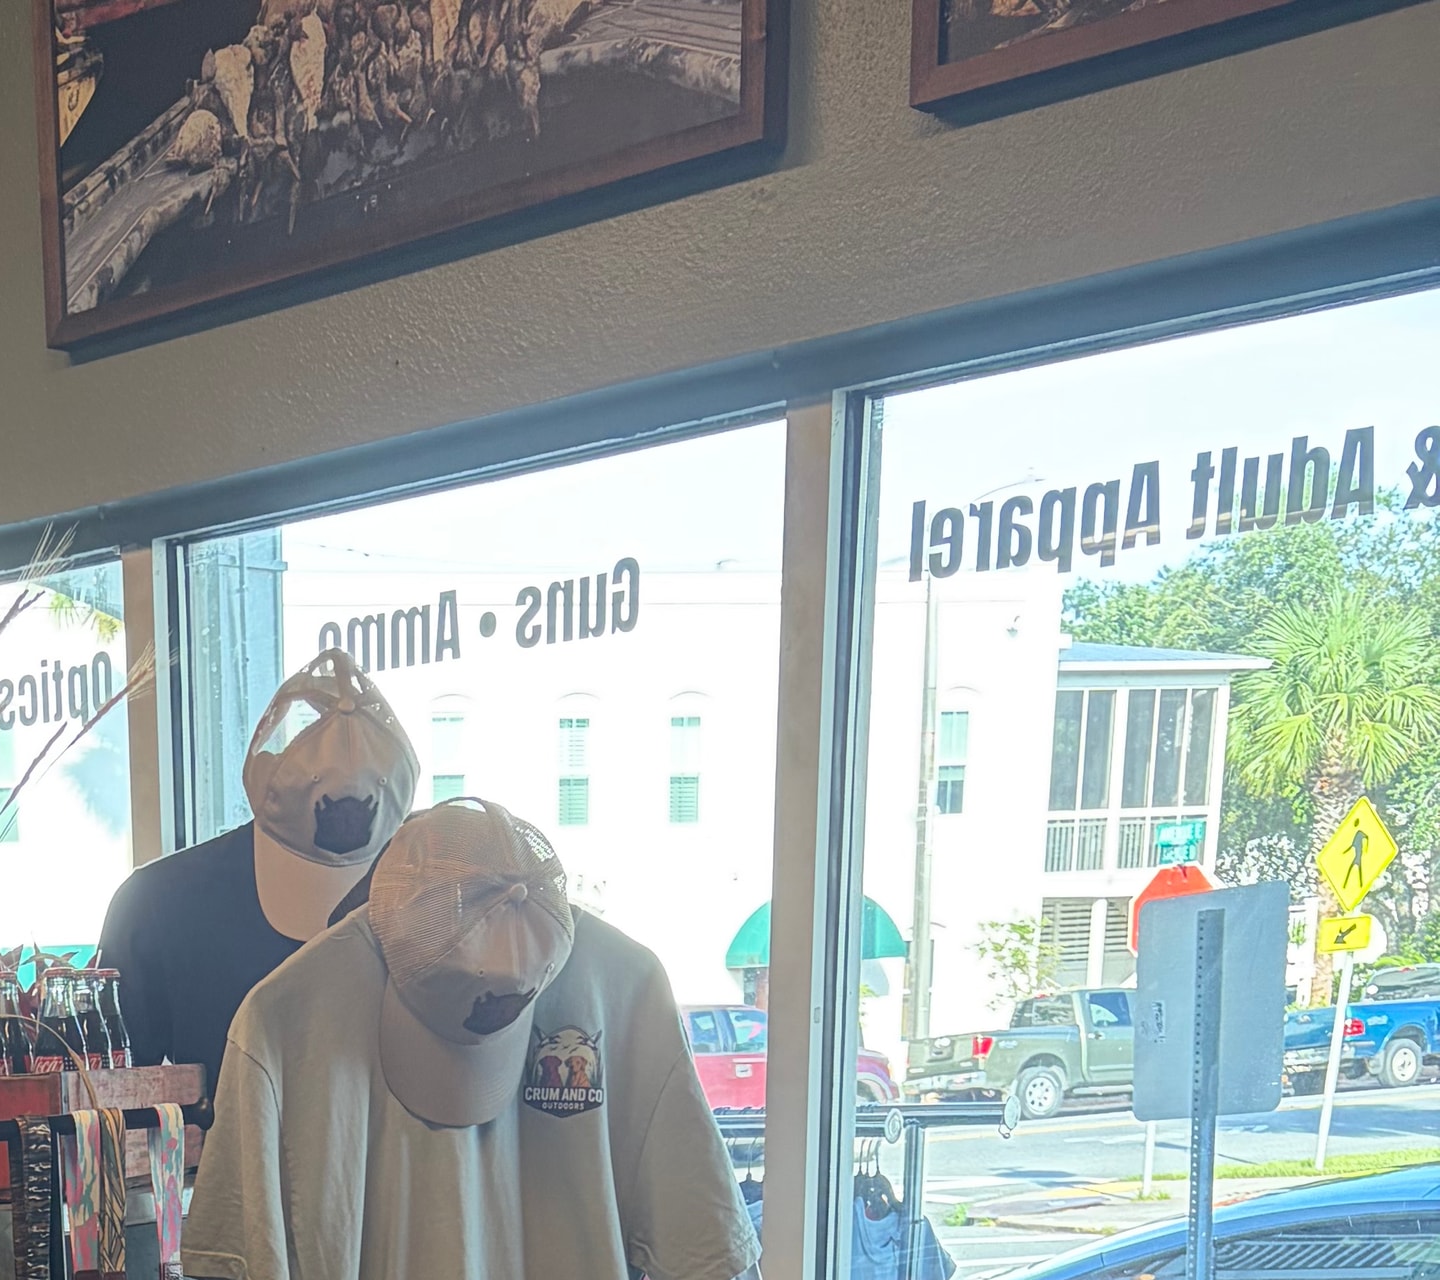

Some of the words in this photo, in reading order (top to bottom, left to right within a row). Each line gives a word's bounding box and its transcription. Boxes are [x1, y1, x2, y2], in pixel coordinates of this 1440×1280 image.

[524, 1087, 560, 1101] CRUM
[561, 1088, 586, 1102] AND
[587, 1089, 603, 1103] CO
[542, 1102, 585, 1110] OUTDOORS
